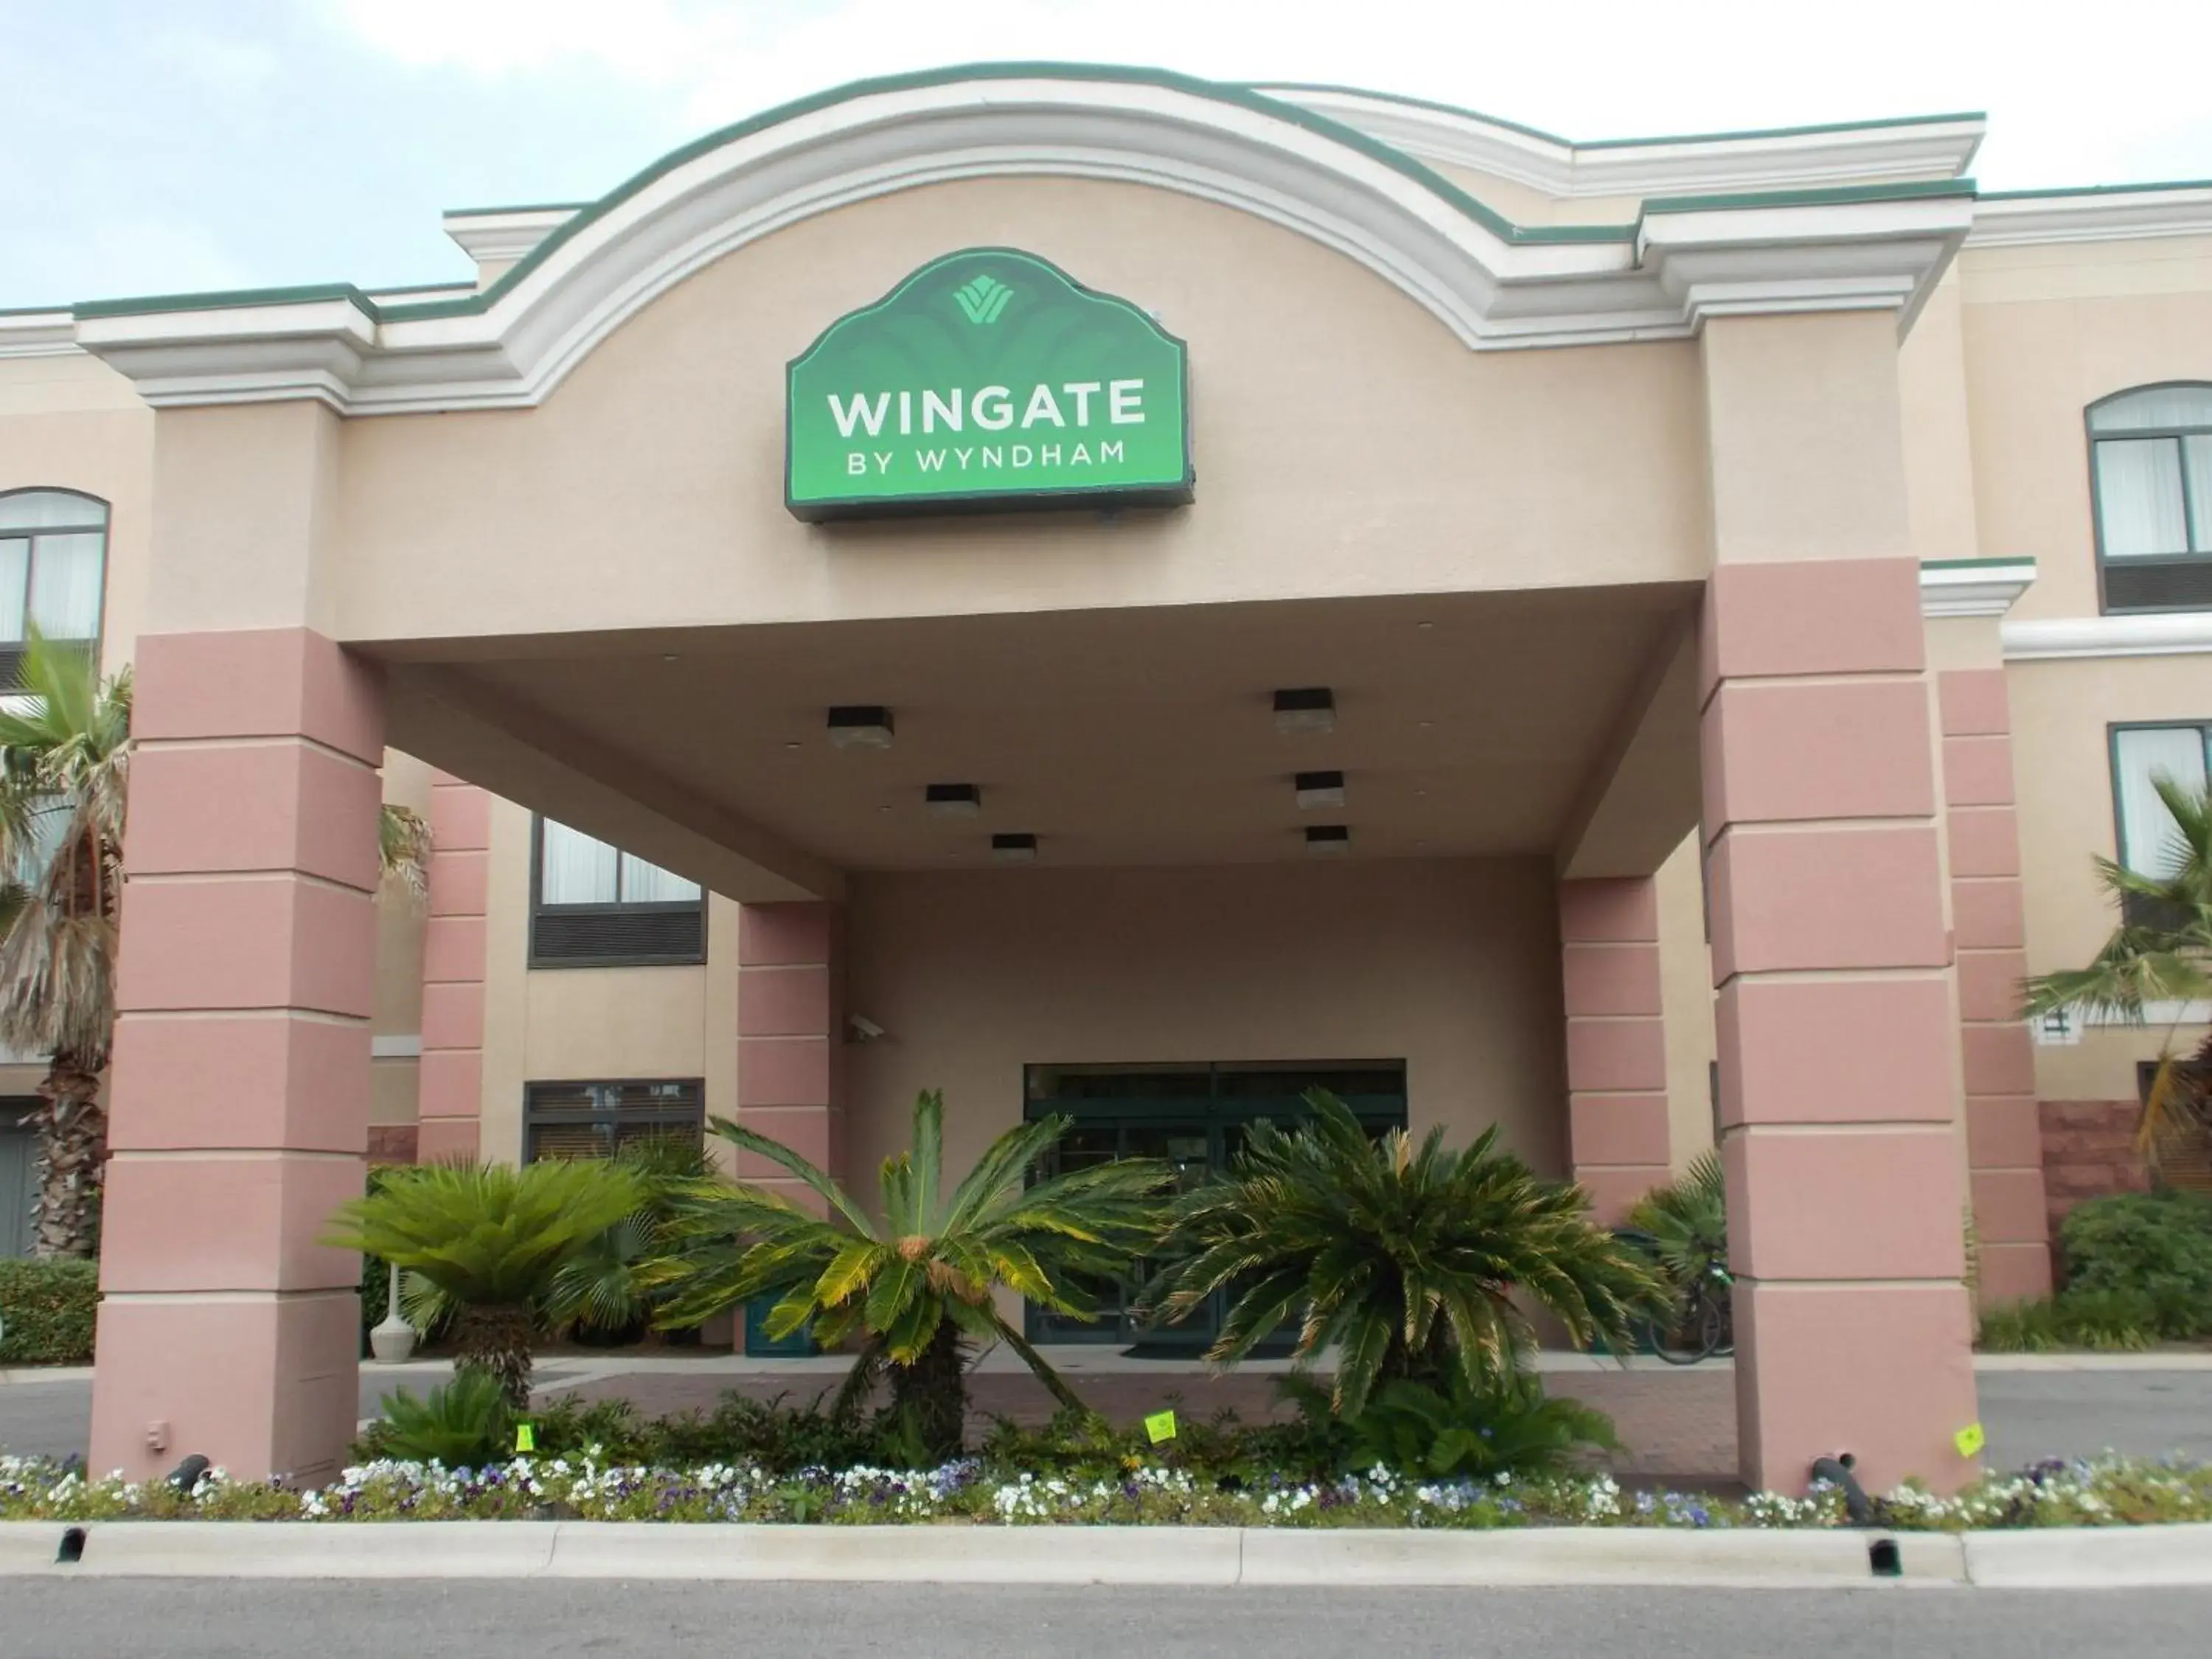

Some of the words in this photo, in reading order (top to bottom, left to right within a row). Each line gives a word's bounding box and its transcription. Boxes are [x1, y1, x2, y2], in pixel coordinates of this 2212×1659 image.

[827, 378, 1146, 438] WINGATE
[847, 451, 894, 476] BY
[916, 439, 1124, 472] WYNDHAM
